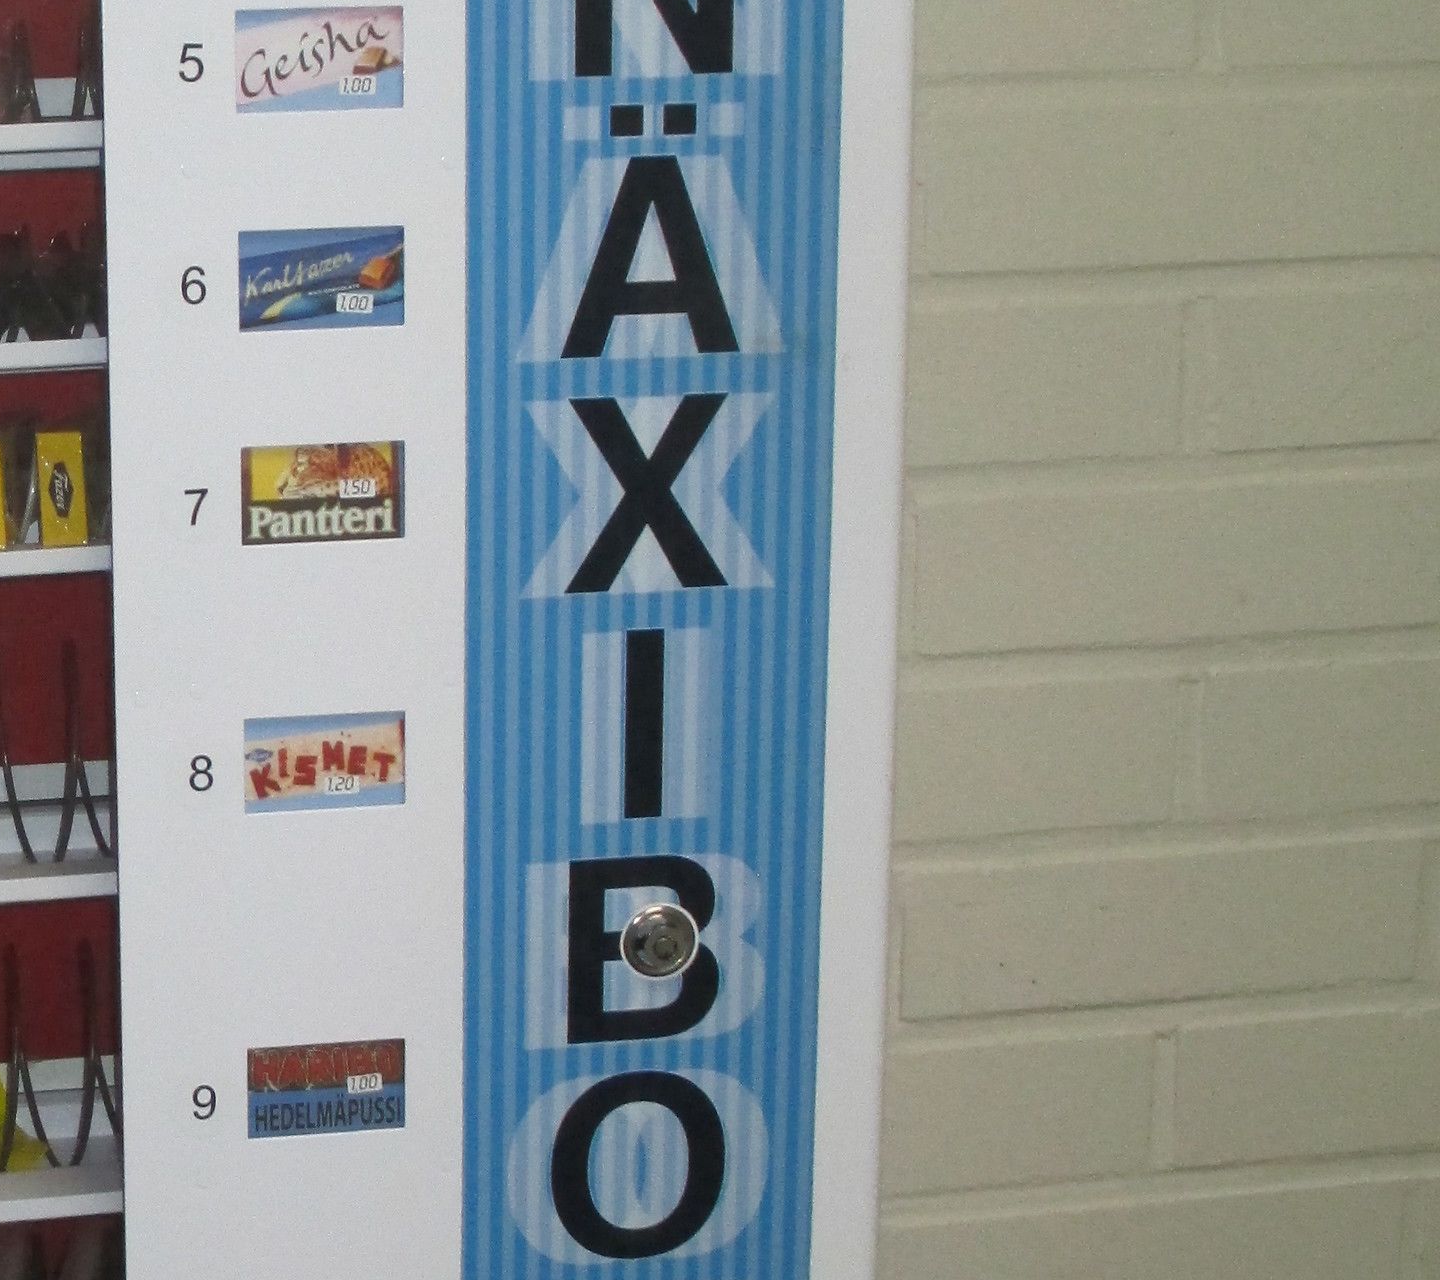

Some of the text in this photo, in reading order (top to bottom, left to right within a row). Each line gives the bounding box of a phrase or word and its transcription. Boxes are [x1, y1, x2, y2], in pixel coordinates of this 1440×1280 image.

[178, 43, 205, 83] 5
[239, 17, 390, 99] Geisha
[180, 265, 207, 305] 6
[183, 487, 209, 527] 7
[246, 498, 397, 541] Pantteri
[188, 754, 214, 792] 8
[249, 740, 396, 800] KISMET
[191, 1084, 217, 1121] 9
[254, 1093, 402, 1133] HEDELMÄPUSSI
